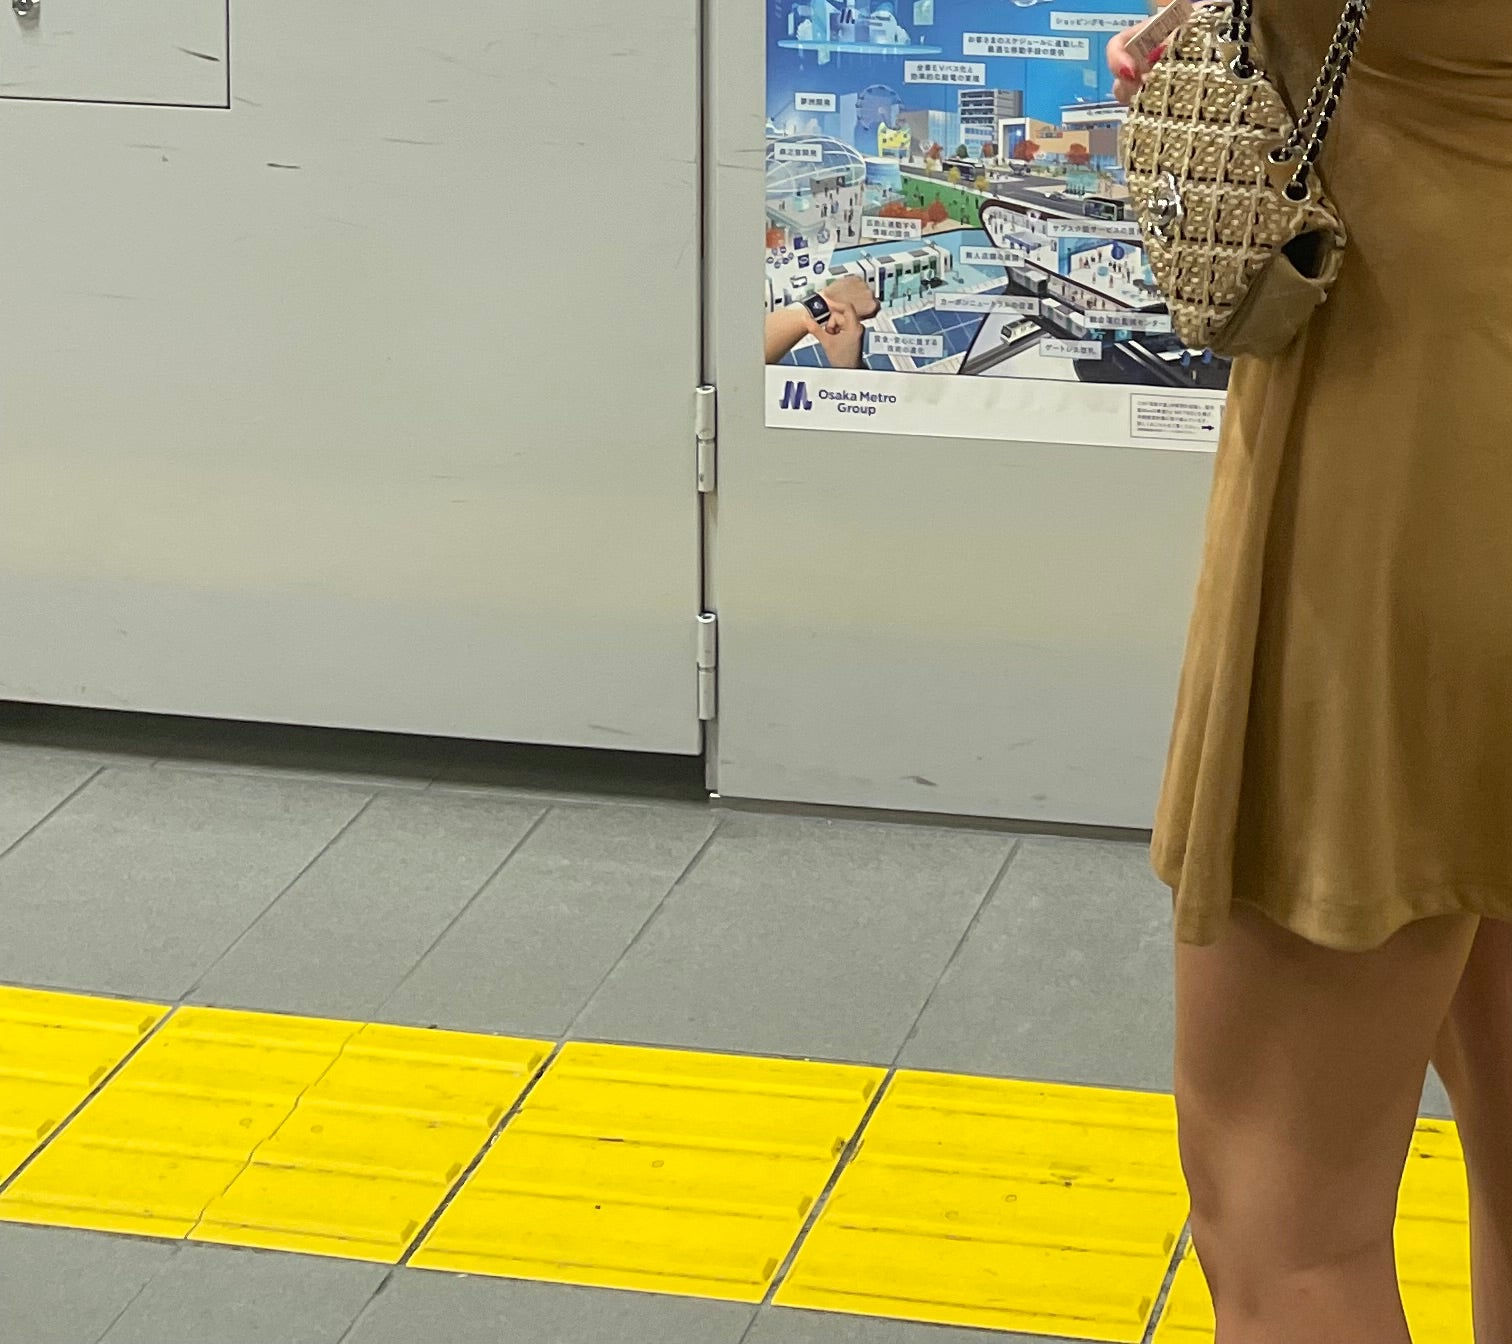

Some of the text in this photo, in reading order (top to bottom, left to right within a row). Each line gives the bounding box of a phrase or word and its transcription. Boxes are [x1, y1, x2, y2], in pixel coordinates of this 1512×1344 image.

[818, 389, 896, 403] Osaka Metro
[837, 403, 876, 416] Group
